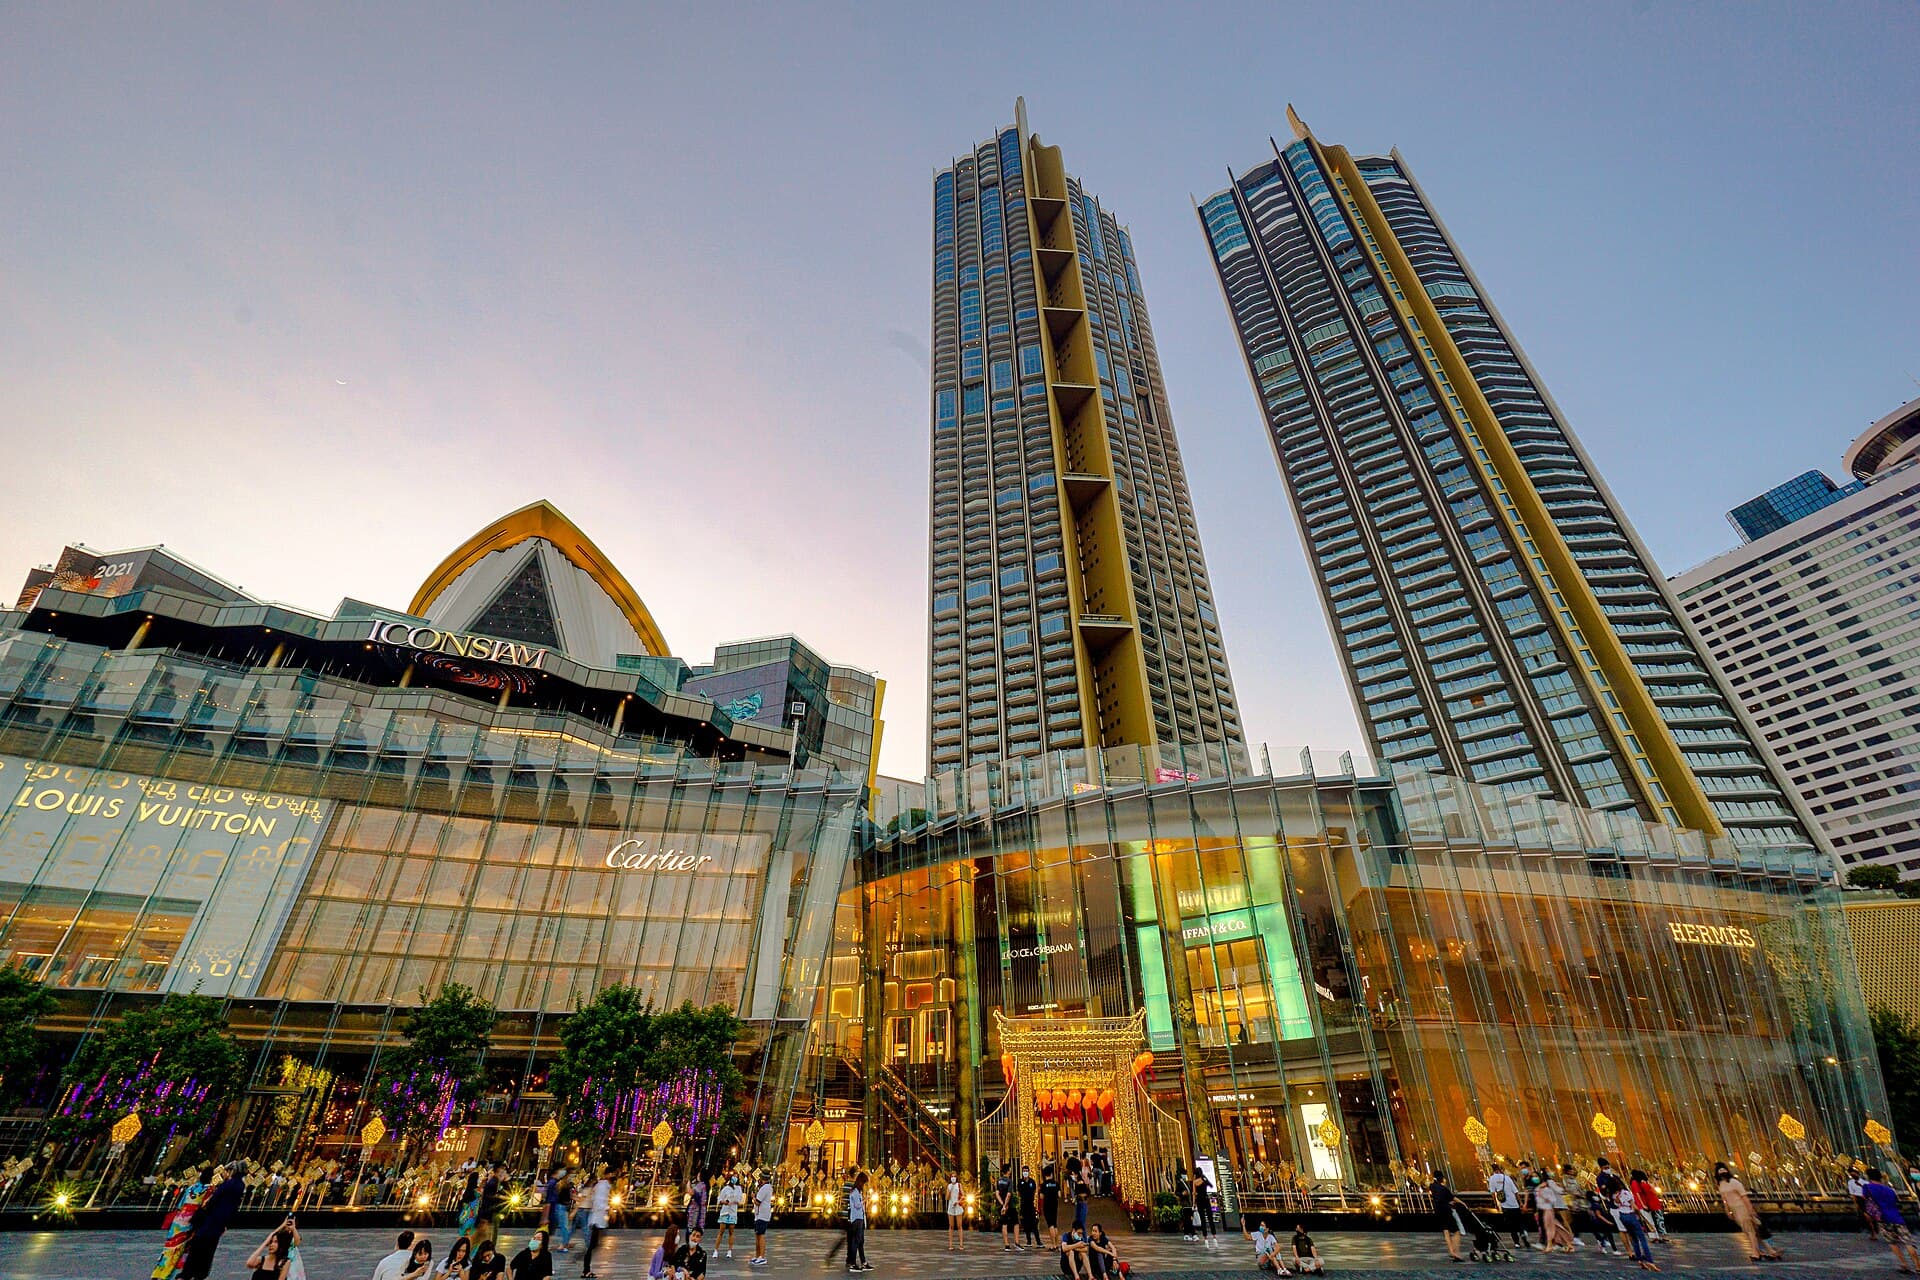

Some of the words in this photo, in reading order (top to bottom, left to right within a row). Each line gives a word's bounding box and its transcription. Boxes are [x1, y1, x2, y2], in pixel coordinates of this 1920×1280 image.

[93, 562, 134, 579] 2021
[366, 619, 548, 669] ICONSIAM
[16, 786, 125, 818] LOUIS
[137, 801, 277, 837] VUITTON
[605, 839, 712, 871] Cartier
[1182, 924, 1217, 940] IFFANY
[851, 943, 904, 955] BVARI
[824, 1109, 847, 1118] ALLY
[436, 1140, 468, 1152] Chilli
